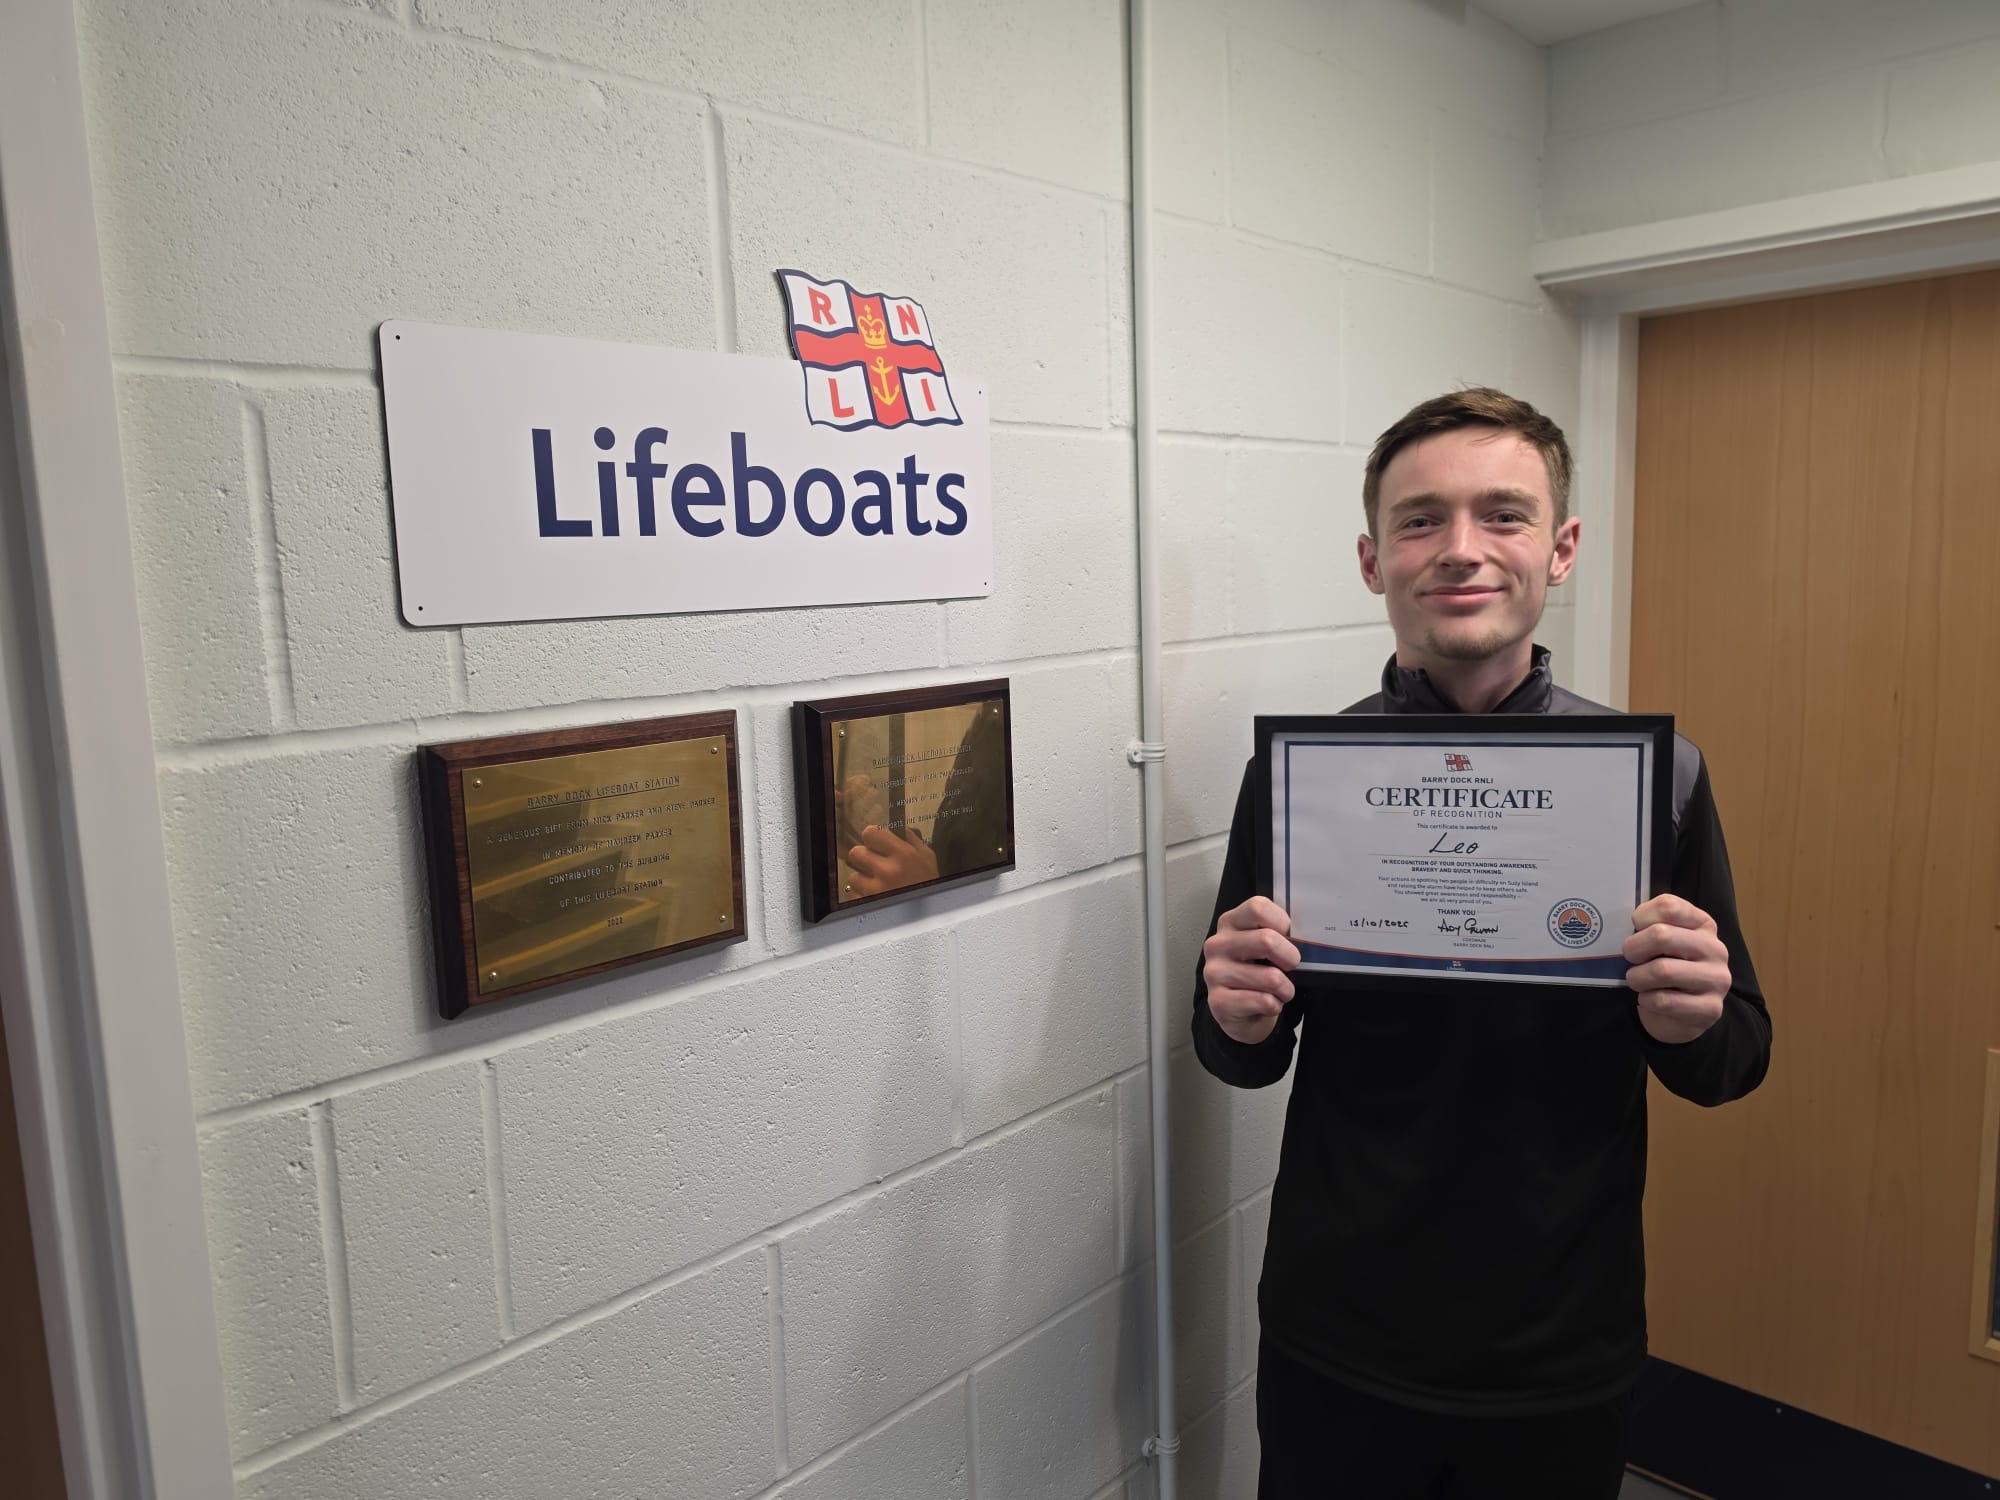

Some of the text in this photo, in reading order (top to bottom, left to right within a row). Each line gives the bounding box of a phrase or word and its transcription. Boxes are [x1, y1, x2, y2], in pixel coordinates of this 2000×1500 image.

[532, 426, 968, 537] Lifeboats
[528, 776, 680, 809] BARRY DOCK LIFEBOAT STATION
[1366, 786, 1553, 809] CERTIFICATE
[545, 824, 561, 833] GIFT
[616, 810, 644, 821] PARKER
[646, 828, 672, 840] PARKER
[1429, 832, 1479, 854] Leo
[549, 868, 600, 884] CONTRIBUTED
[620, 861, 632, 869] THE
[637, 853, 670, 865] BUILDING
[574, 894, 591, 905] THIS
[634, 879, 663, 892] STATION
